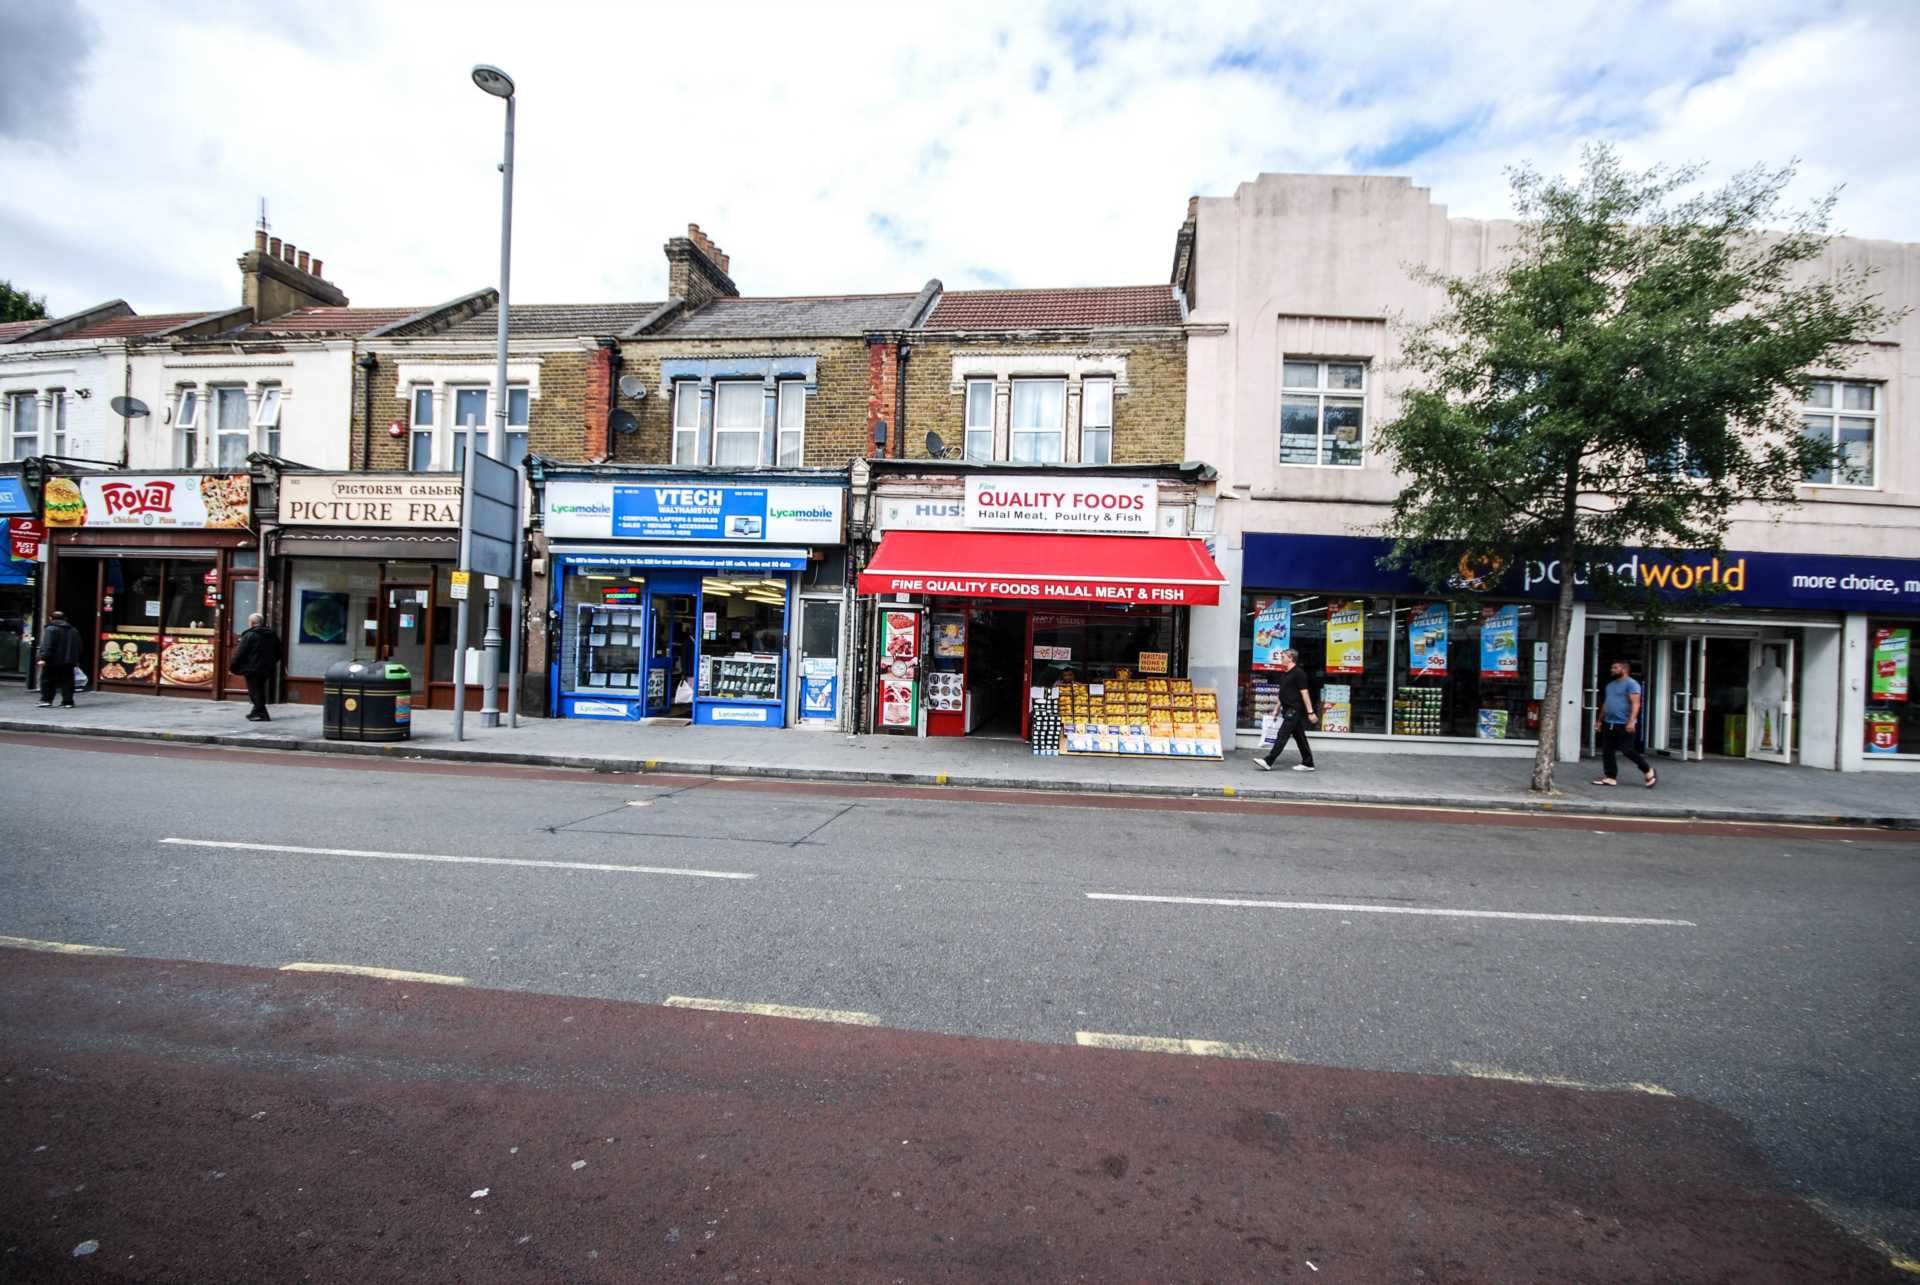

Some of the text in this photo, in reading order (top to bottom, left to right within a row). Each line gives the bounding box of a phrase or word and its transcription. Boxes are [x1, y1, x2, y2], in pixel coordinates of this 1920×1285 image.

[102, 481, 175, 514] Royal
[655, 489, 722, 506] VTECH
[978, 491, 1144, 510] QUALITY FOODS
[290, 501, 462, 521] PICTURE FRA
[551, 503, 610, 514] Lycamobile
[770, 507, 833, 518] Lycamobile
[979, 510, 1142, 523] Halal Meat, Poultry & Fish
[891, 579, 1184, 600] FINE QUALITY FOODS HALAL MEAT & FISH
[1792, 575, 1836, 589] more
[1840, 573, 1899, 594] choice,
[1258, 612, 1287, 621] VALUE
[1428, 655, 1445, 665] 50p
[1875, 733, 1892, 745] £1
